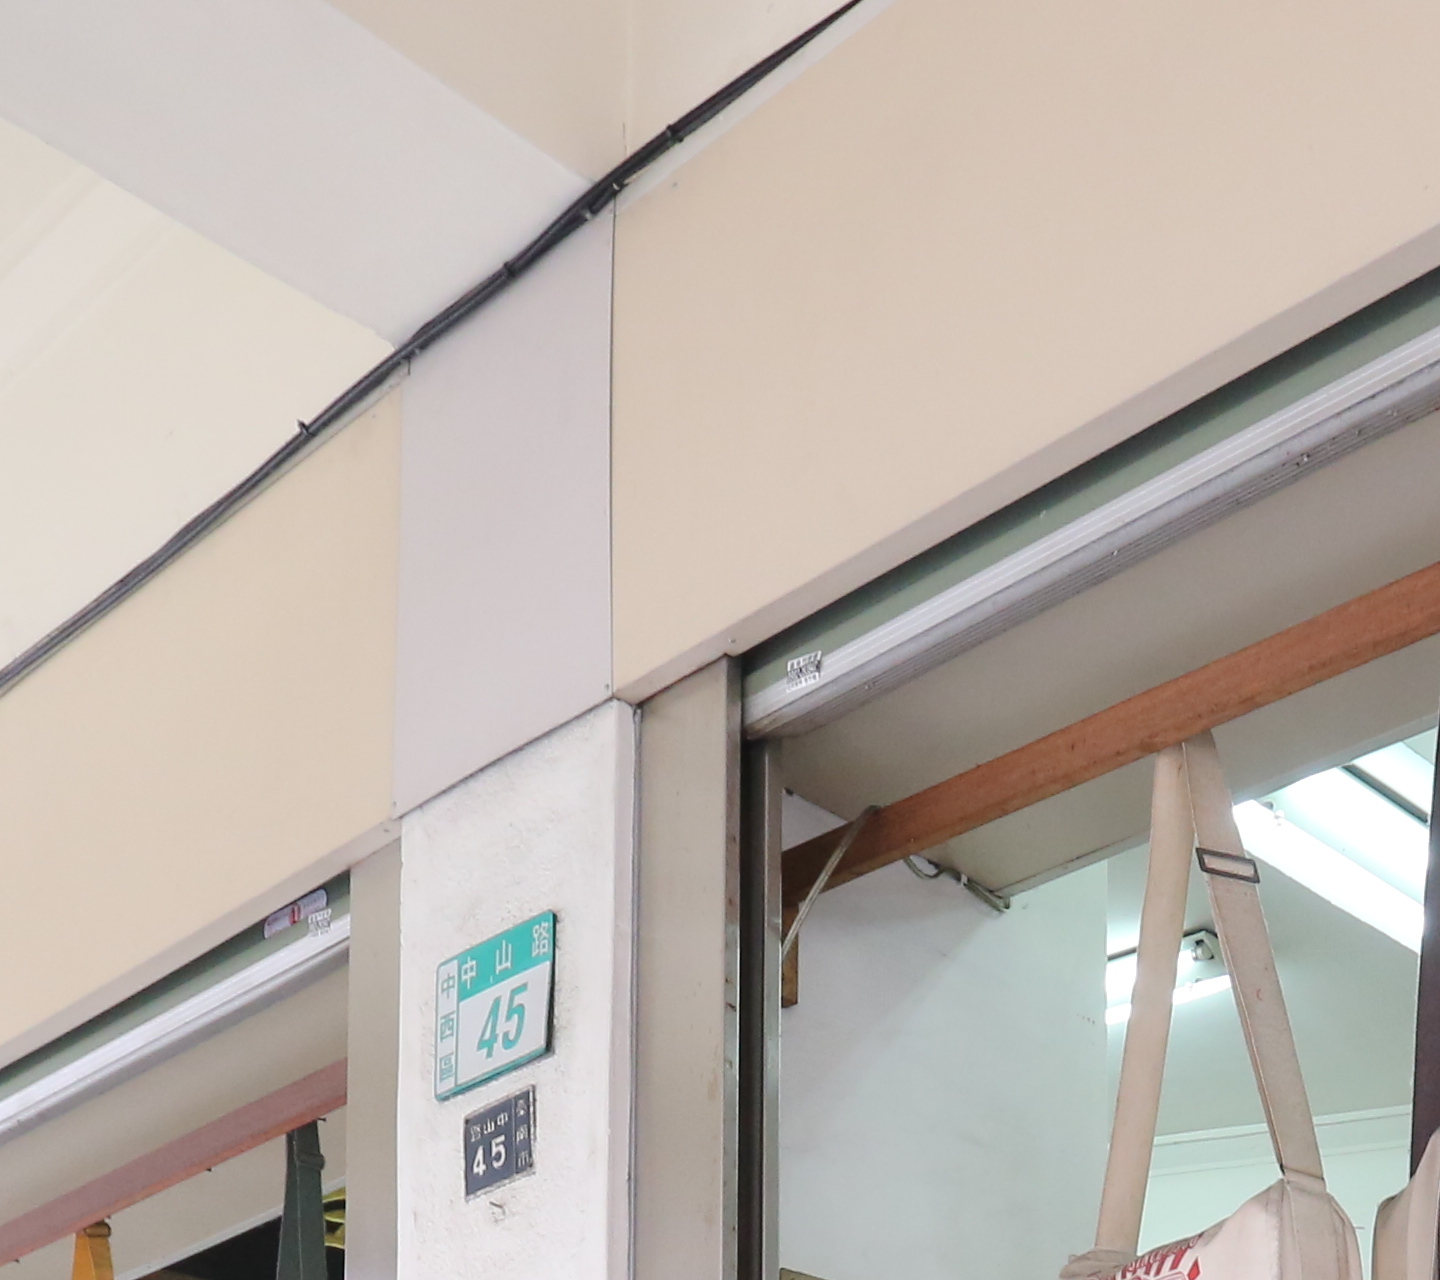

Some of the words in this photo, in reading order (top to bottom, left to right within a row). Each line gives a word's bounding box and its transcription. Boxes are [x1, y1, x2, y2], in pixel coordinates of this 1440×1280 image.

[461, 920, 551, 990] 中山路
[440, 972, 455, 1079] 中西區
[476, 983, 528, 1059] 45
[471, 1136, 506, 1177] 45
